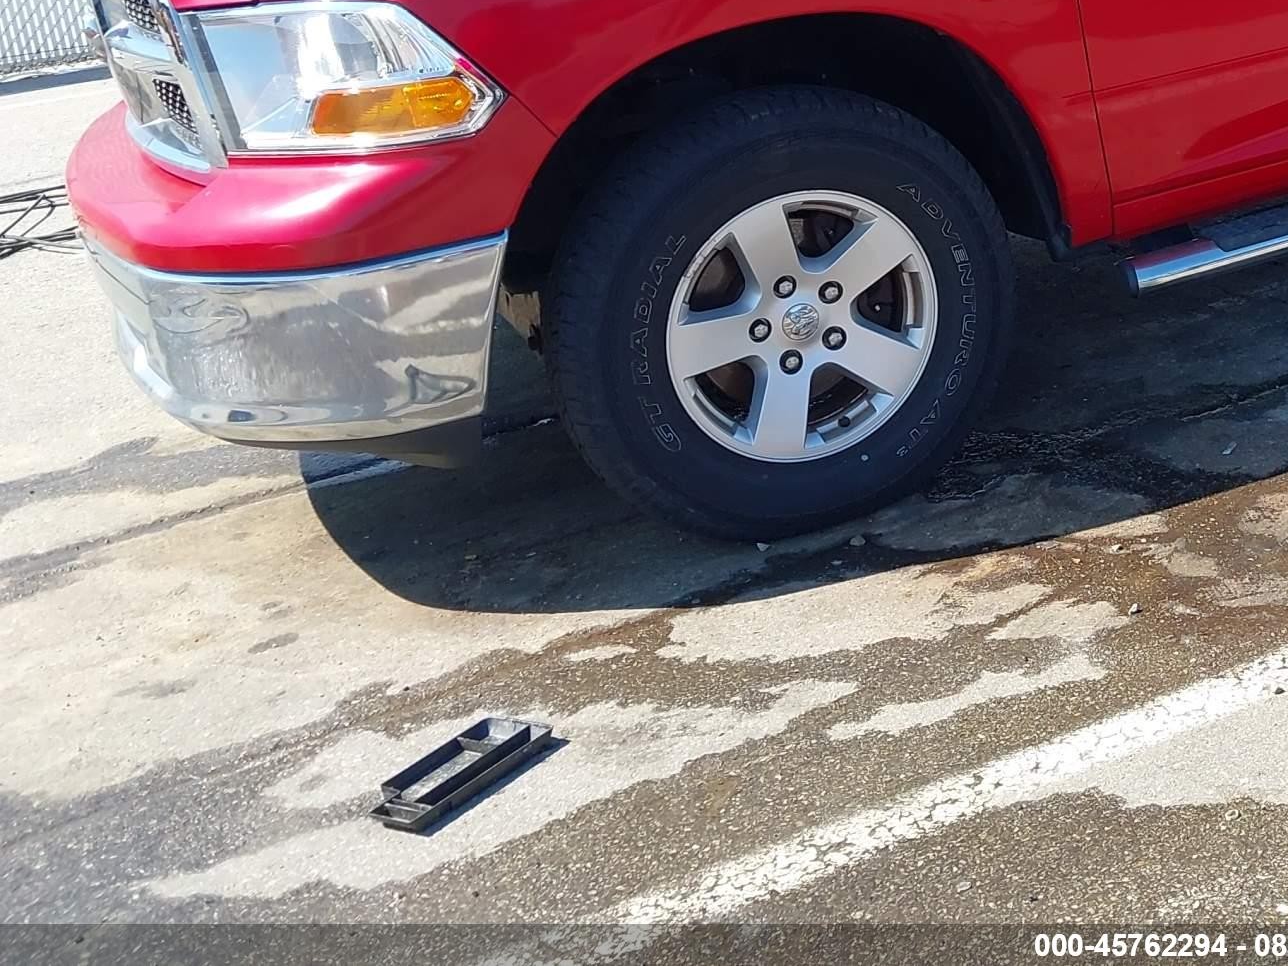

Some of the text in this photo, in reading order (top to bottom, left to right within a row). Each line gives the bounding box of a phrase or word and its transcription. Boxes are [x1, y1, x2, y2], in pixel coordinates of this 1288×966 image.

[630, 233, 687, 453] GT RADIAL
[896, 182, 978, 397] ADVENTURO
